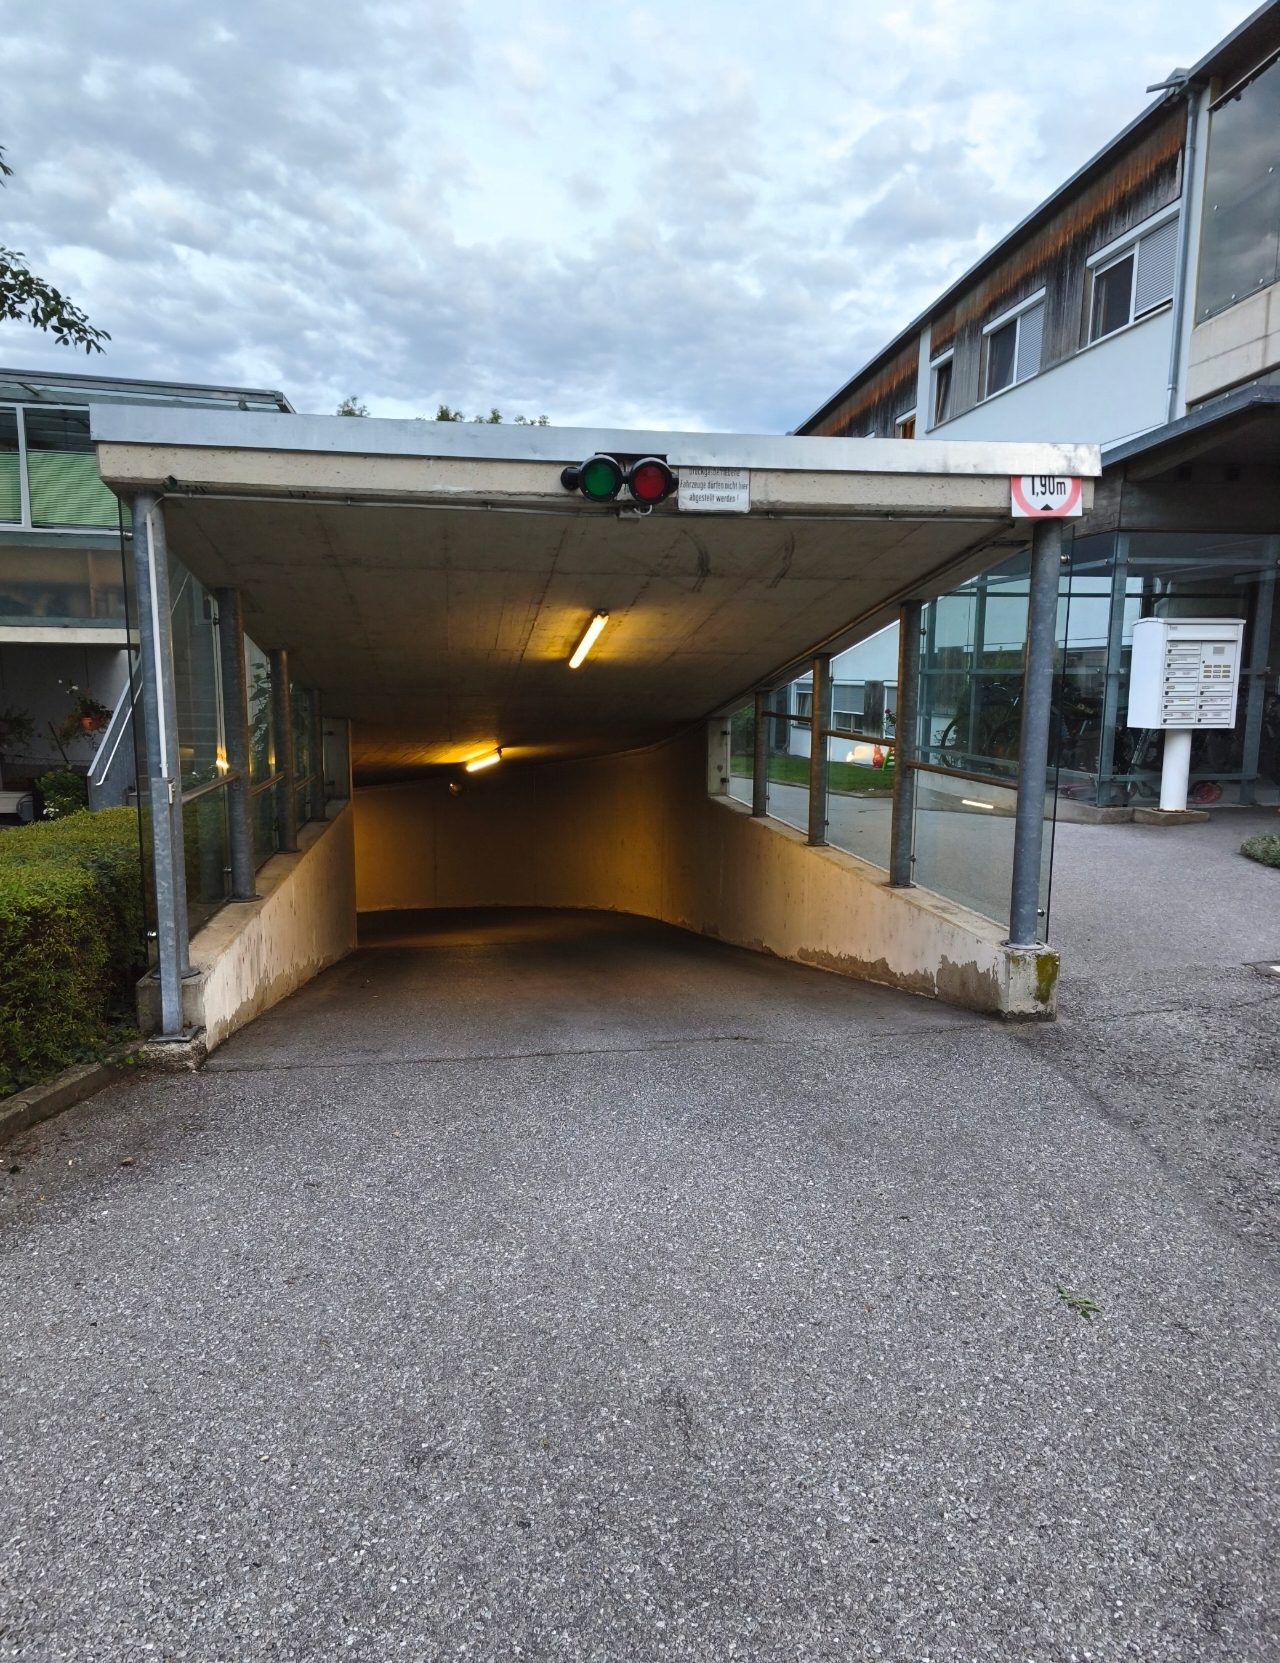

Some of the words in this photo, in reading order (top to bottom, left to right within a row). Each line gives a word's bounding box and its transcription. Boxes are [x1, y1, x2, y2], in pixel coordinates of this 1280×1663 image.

[680, 480, 706, 491] Fahrzeuge
[725, 481, 738, 490] nicht
[1031, 475, 1066, 497] 1,90m
[689, 493, 715, 503] abgestellt
[716, 494, 736, 502] werden
